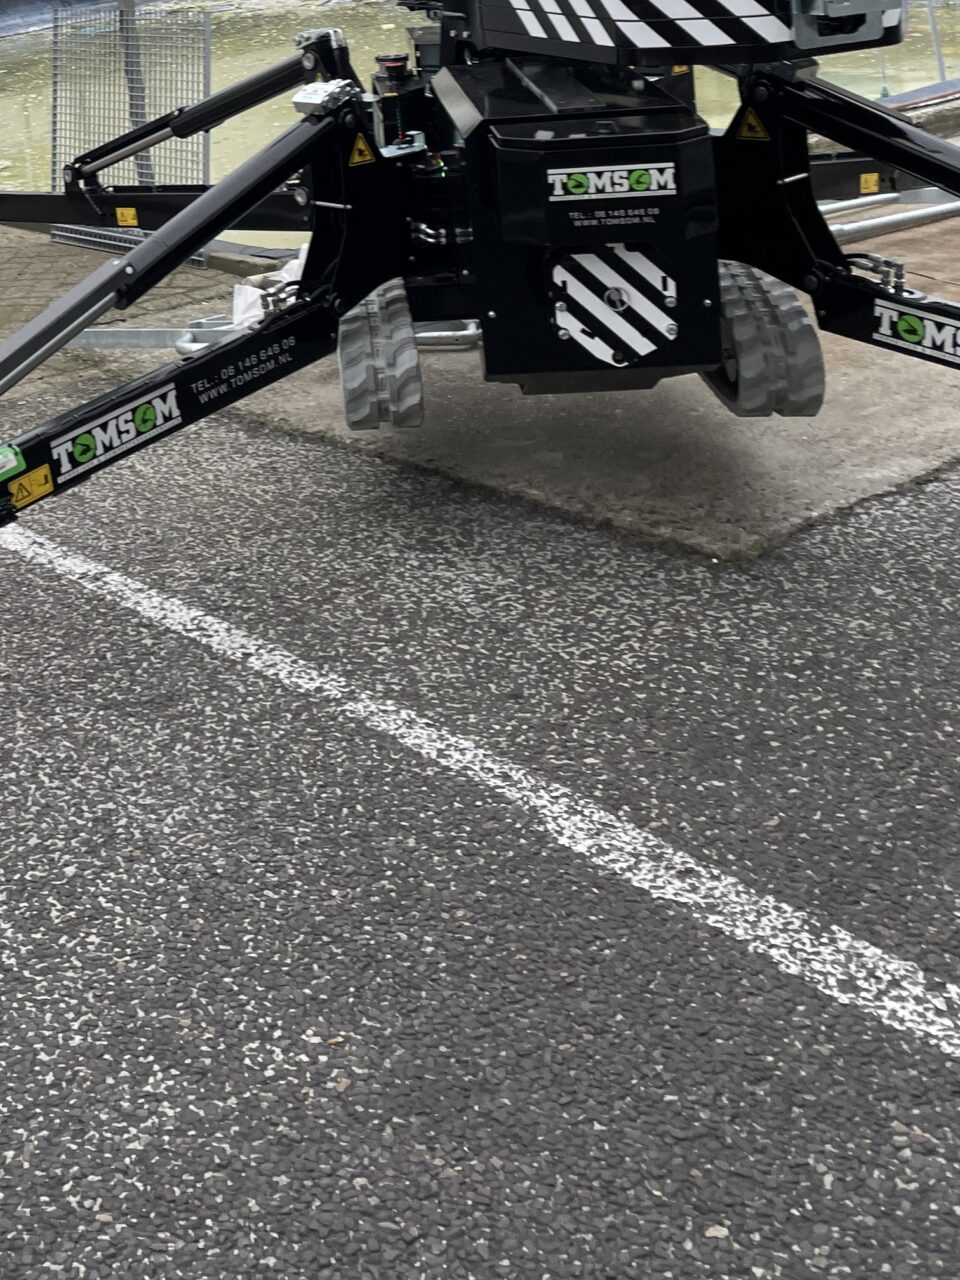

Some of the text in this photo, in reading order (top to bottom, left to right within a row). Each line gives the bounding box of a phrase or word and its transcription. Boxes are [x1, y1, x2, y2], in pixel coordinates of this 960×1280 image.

[547, 167, 677, 196] TOMSOM
[873, 306, 960, 356] TOM
[198, 352, 294, 404] WWW.TOMSOM.NL
[220, 365, 236, 380] 06
[238, 354, 258, 371] 146
[259, 343, 281, 360] 646
[281, 335, 297, 350] 06
[51, 389, 181, 474] TOMSOM
